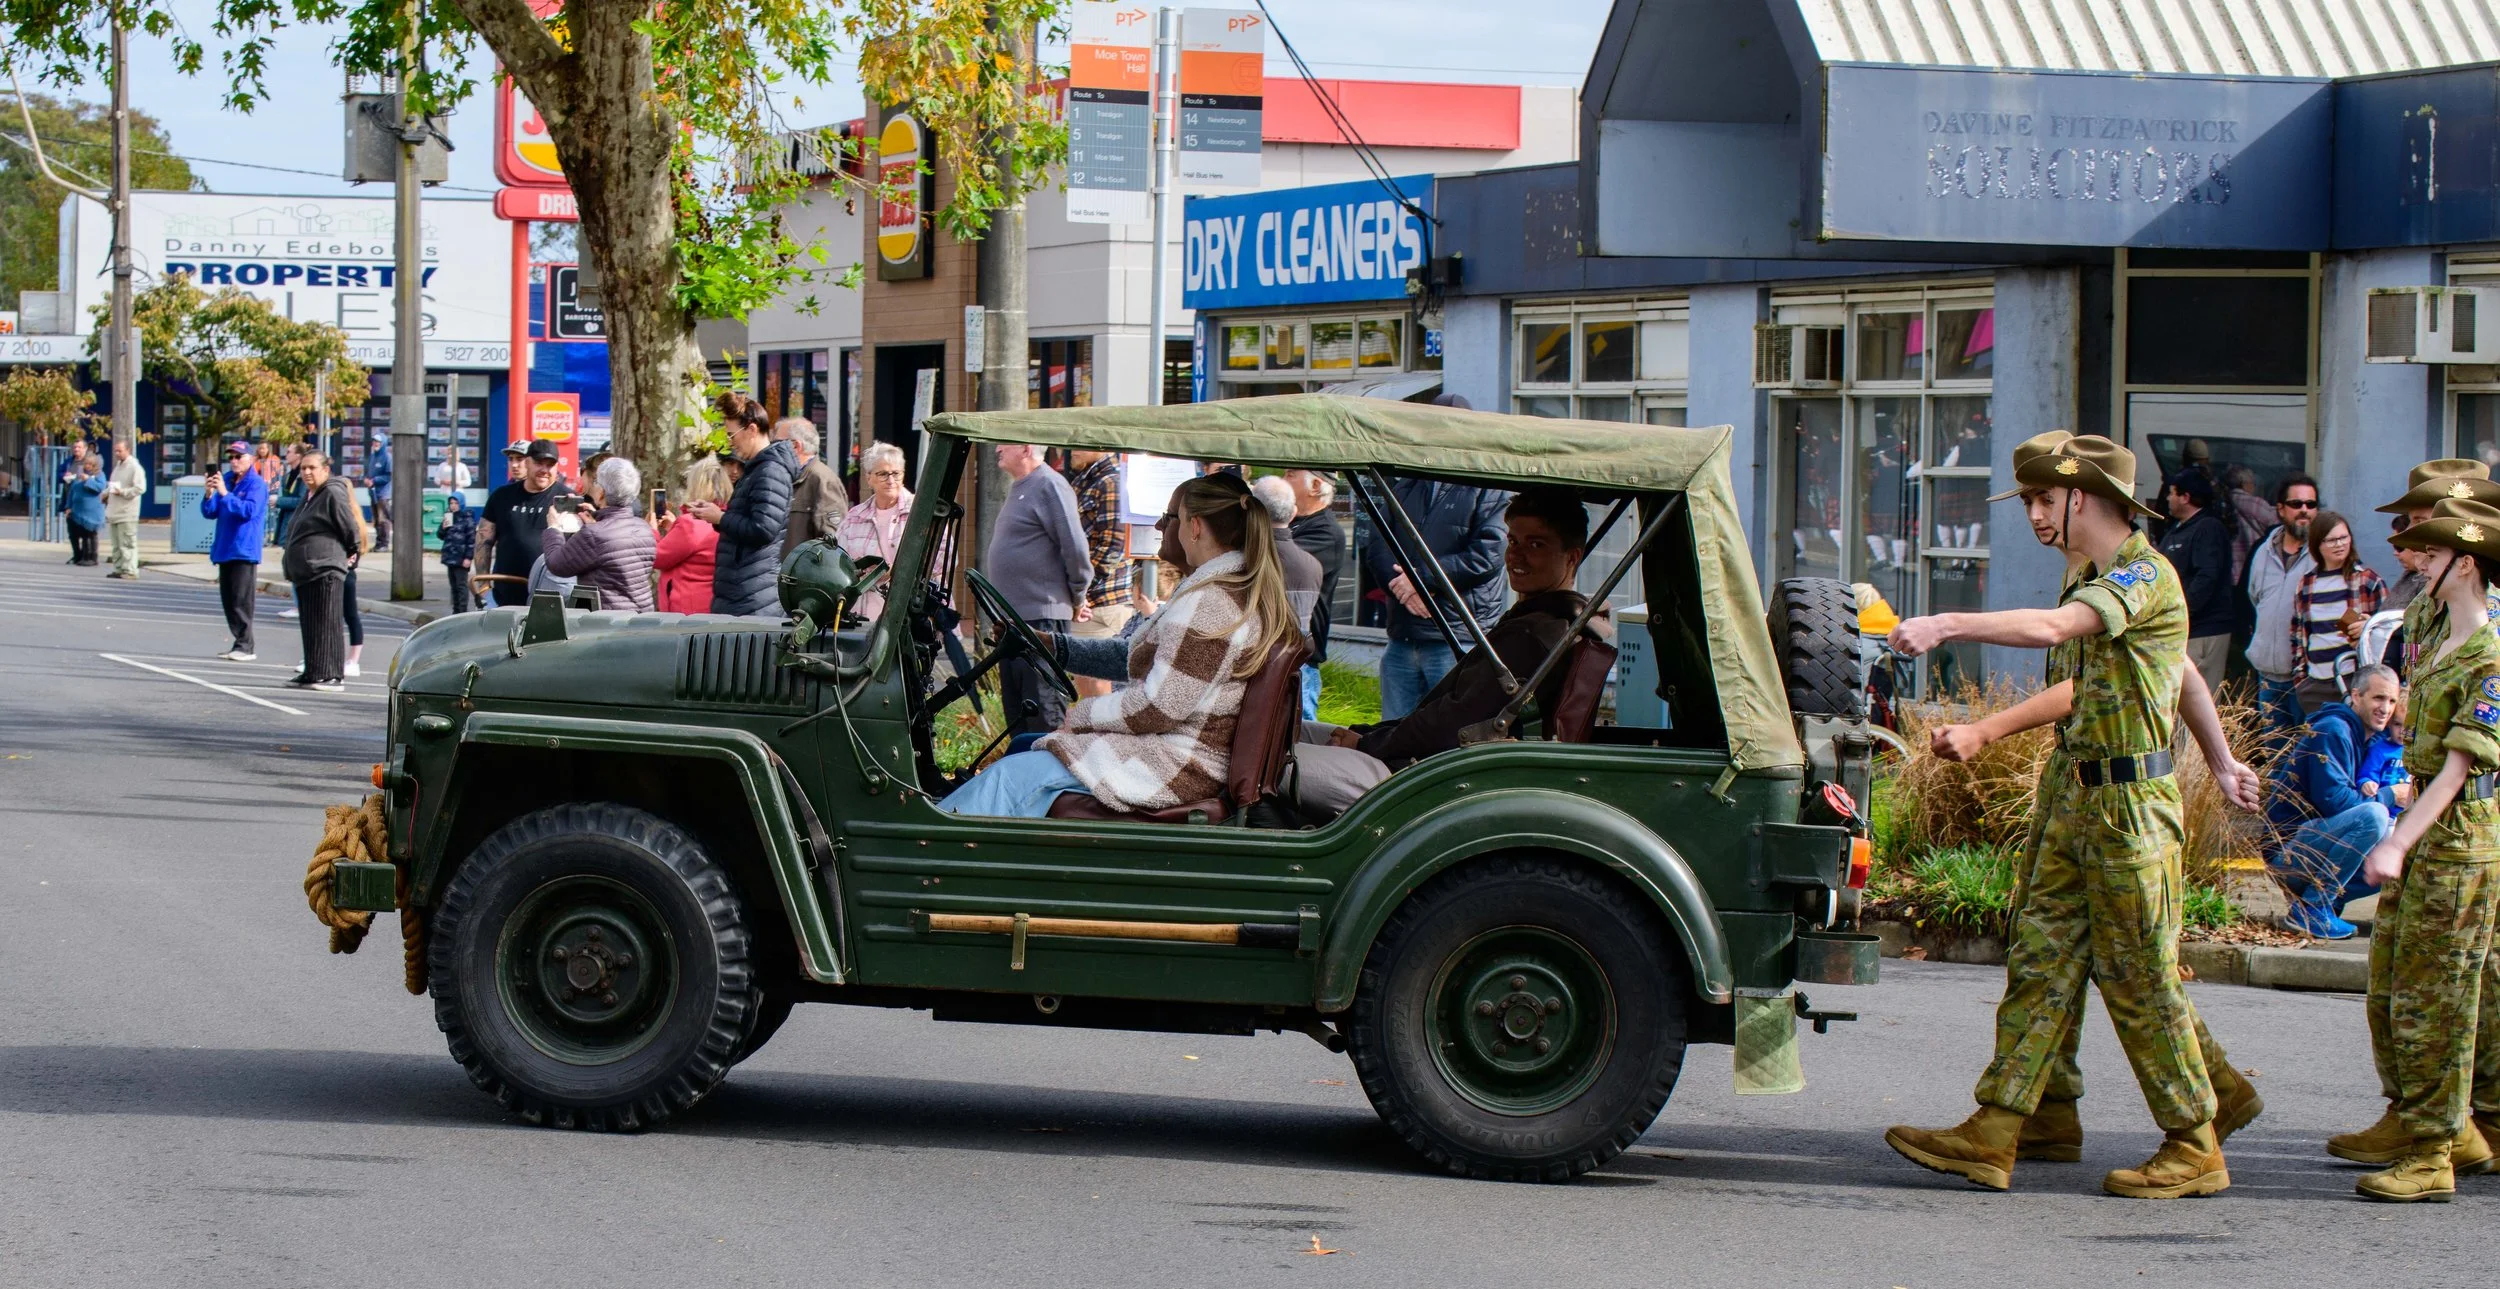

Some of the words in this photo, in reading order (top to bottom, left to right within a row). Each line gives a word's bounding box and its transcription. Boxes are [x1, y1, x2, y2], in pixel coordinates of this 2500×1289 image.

[1095, 49, 1117, 61] Moe
[1120, 51, 1146, 62] Town
[1127, 63, 1146, 73] Hall
[1073, 91, 1092, 99] Route
[1096, 92, 1105, 100] To
[1208, 98, 1217, 106] To
[1073, 107, 1080, 119] 1
[1184, 113, 1198, 126] 14
[1208, 116, 1247, 126] Newborough
[1072, 128, 1082, 141] 5
[2051, 114, 2239, 143] FITZPATRICK
[1184, 135, 1198, 147] 15
[1072, 151, 1084, 163] 11
[1072, 172, 1085, 184] 12
[1926, 143, 2232, 205] SOLICITORS
[539, 193, 579, 216] DRI
[166, 239, 266, 256] Danny
[287, 240, 437, 257] Edebos
[1186, 215, 1246, 291] DRY
[1256, 198, 1421, 287] CLEANERS
[12, 341, 51, 356] 2000
[444, 346, 474, 362] 5127
[480, 347, 511, 362] 200
[535, 412, 570, 420] HUNGRY
